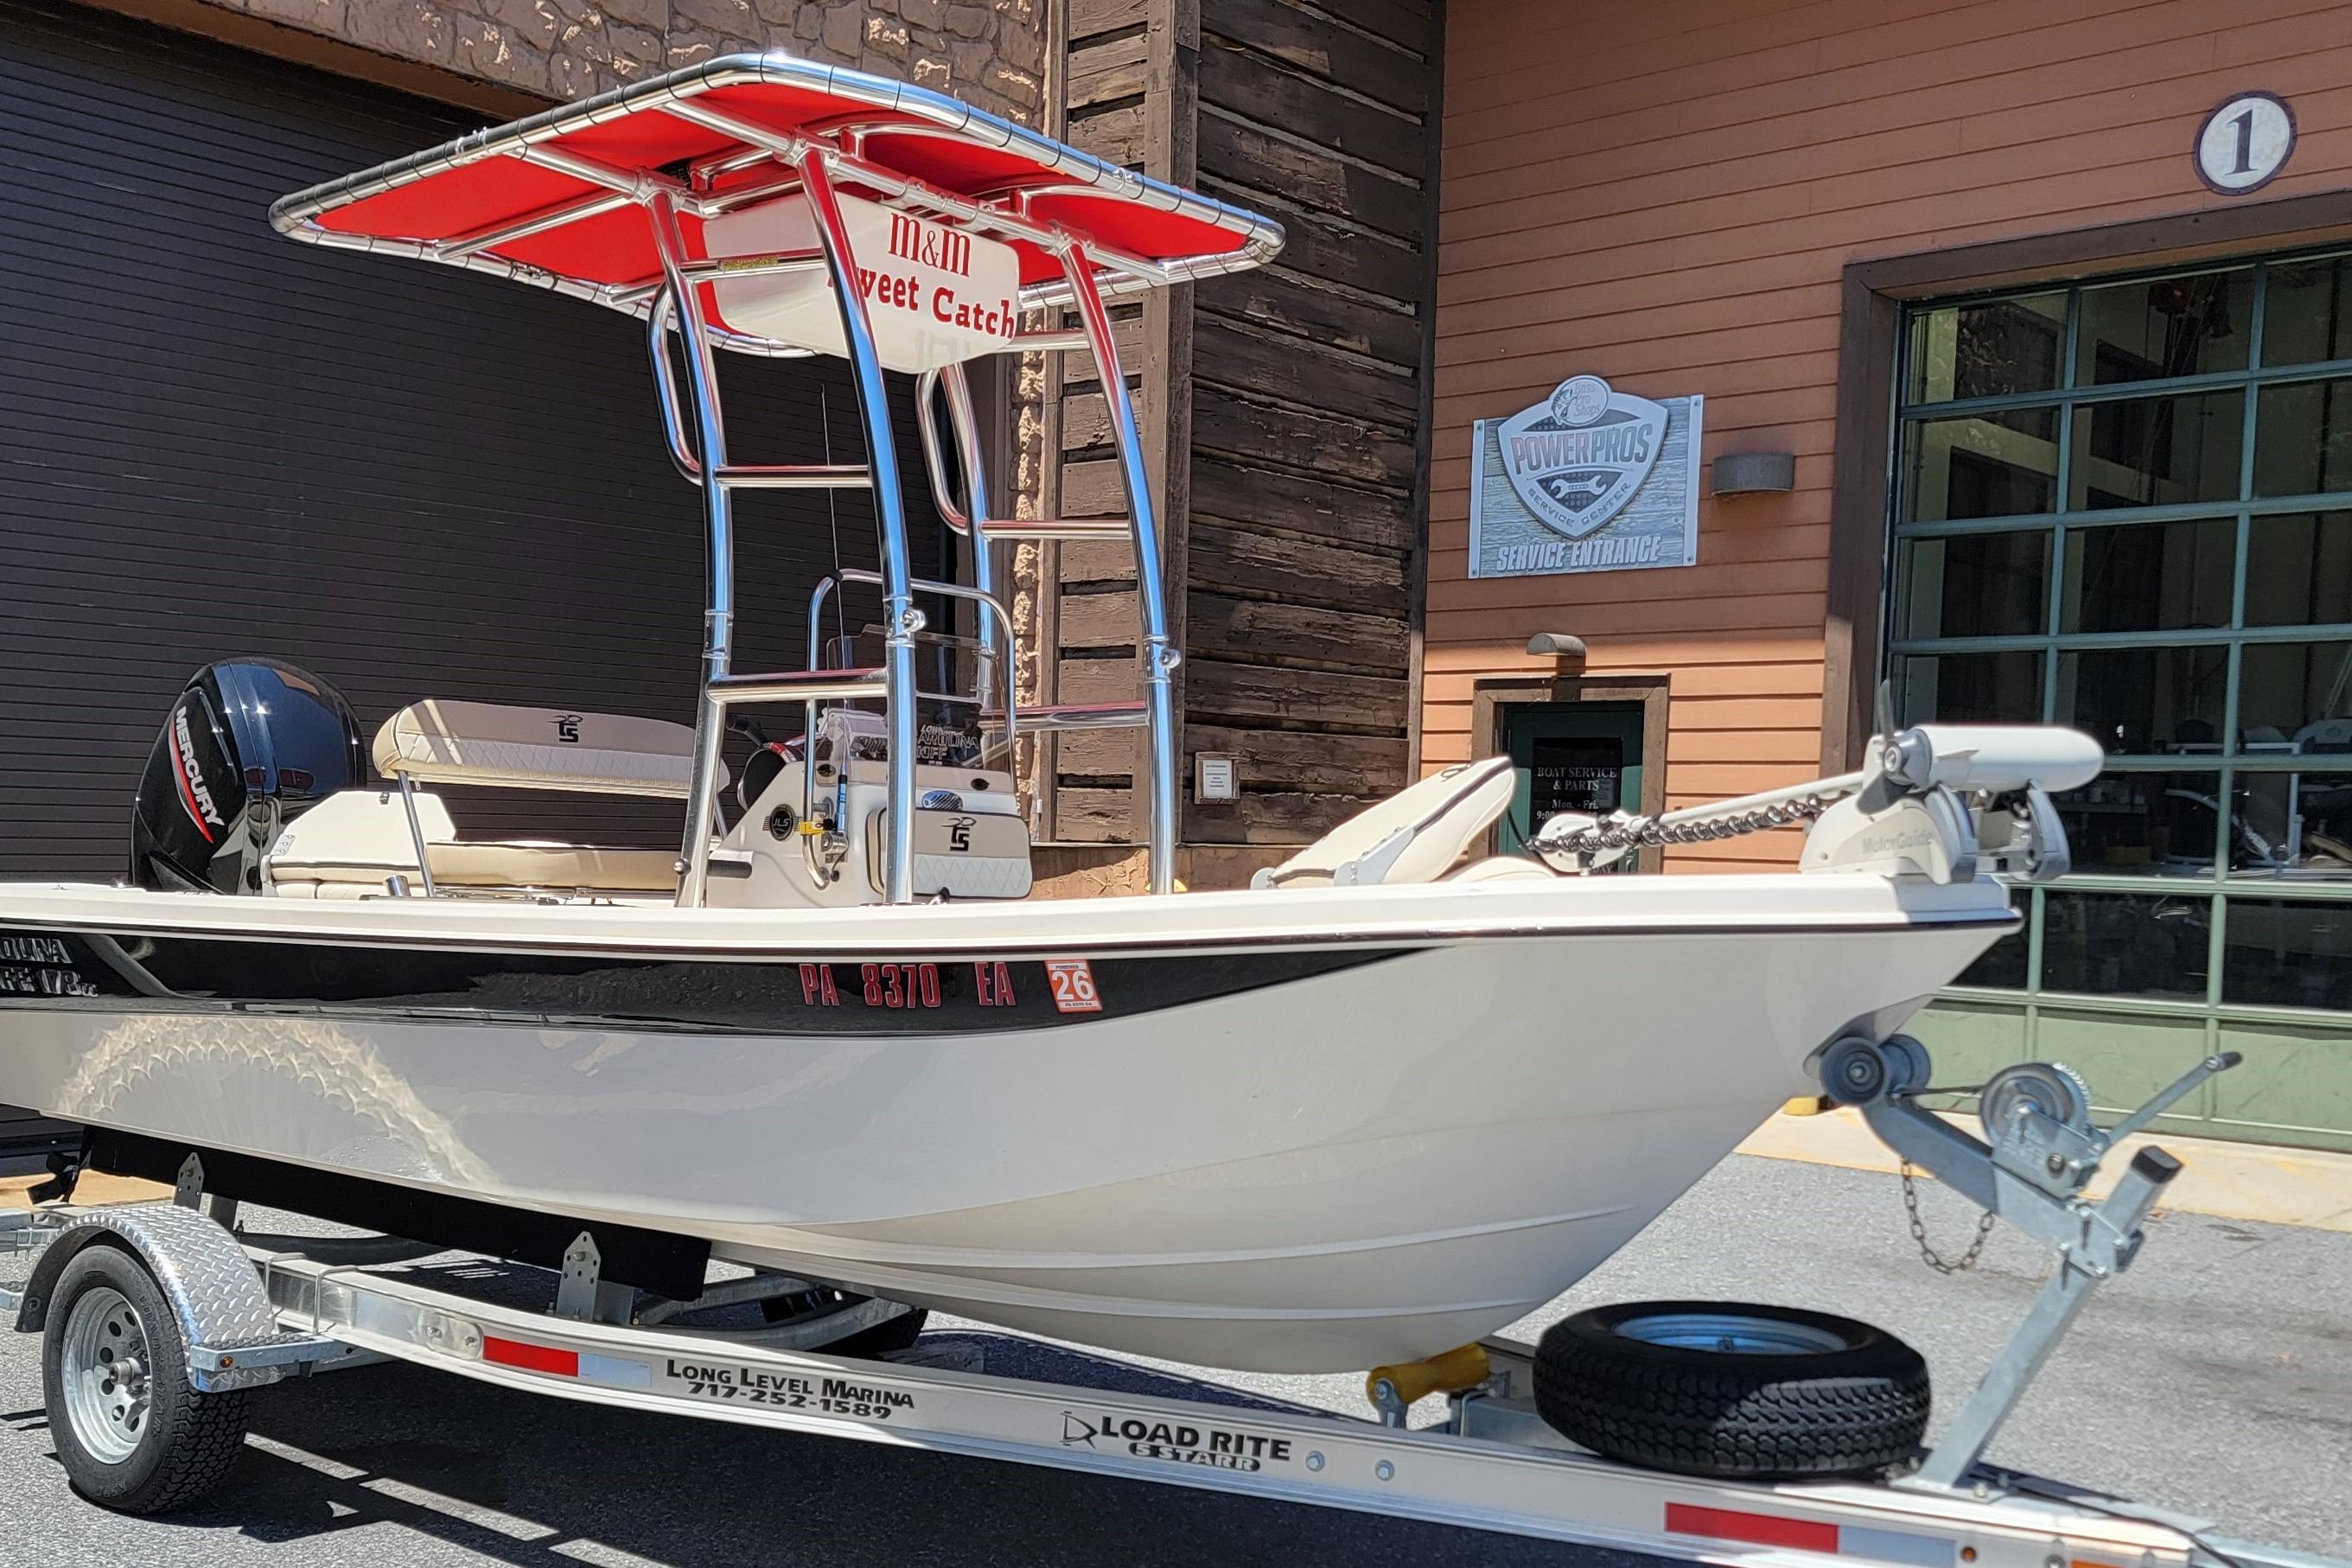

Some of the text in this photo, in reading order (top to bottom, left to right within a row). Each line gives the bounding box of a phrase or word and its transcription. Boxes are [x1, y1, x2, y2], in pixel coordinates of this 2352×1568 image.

[2224, 108, 2259, 176] 1
[827, 266, 1015, 340] weet Catch
[1527, 481, 1632, 528] SERVICE CENTER
[1495, 534, 1661, 572] SERVICE ENTRANCE
[916, 732, 979, 750] AROLINA
[916, 745, 948, 760] KIFF
[175, 705, 226, 826] MERCURY
[1536, 767, 1617, 779] BOAT SERVICE
[1552, 780, 1600, 792] & PARTS
[799, 961, 1017, 1009] PA 8370 EA
[1051, 970, 1093, 1000] 26
[688, 1381, 892, 1420] 717-252-1589
[1101, 1417, 1291, 1462] LOAD RITE
[1134, 1444, 1151, 1456] 5
